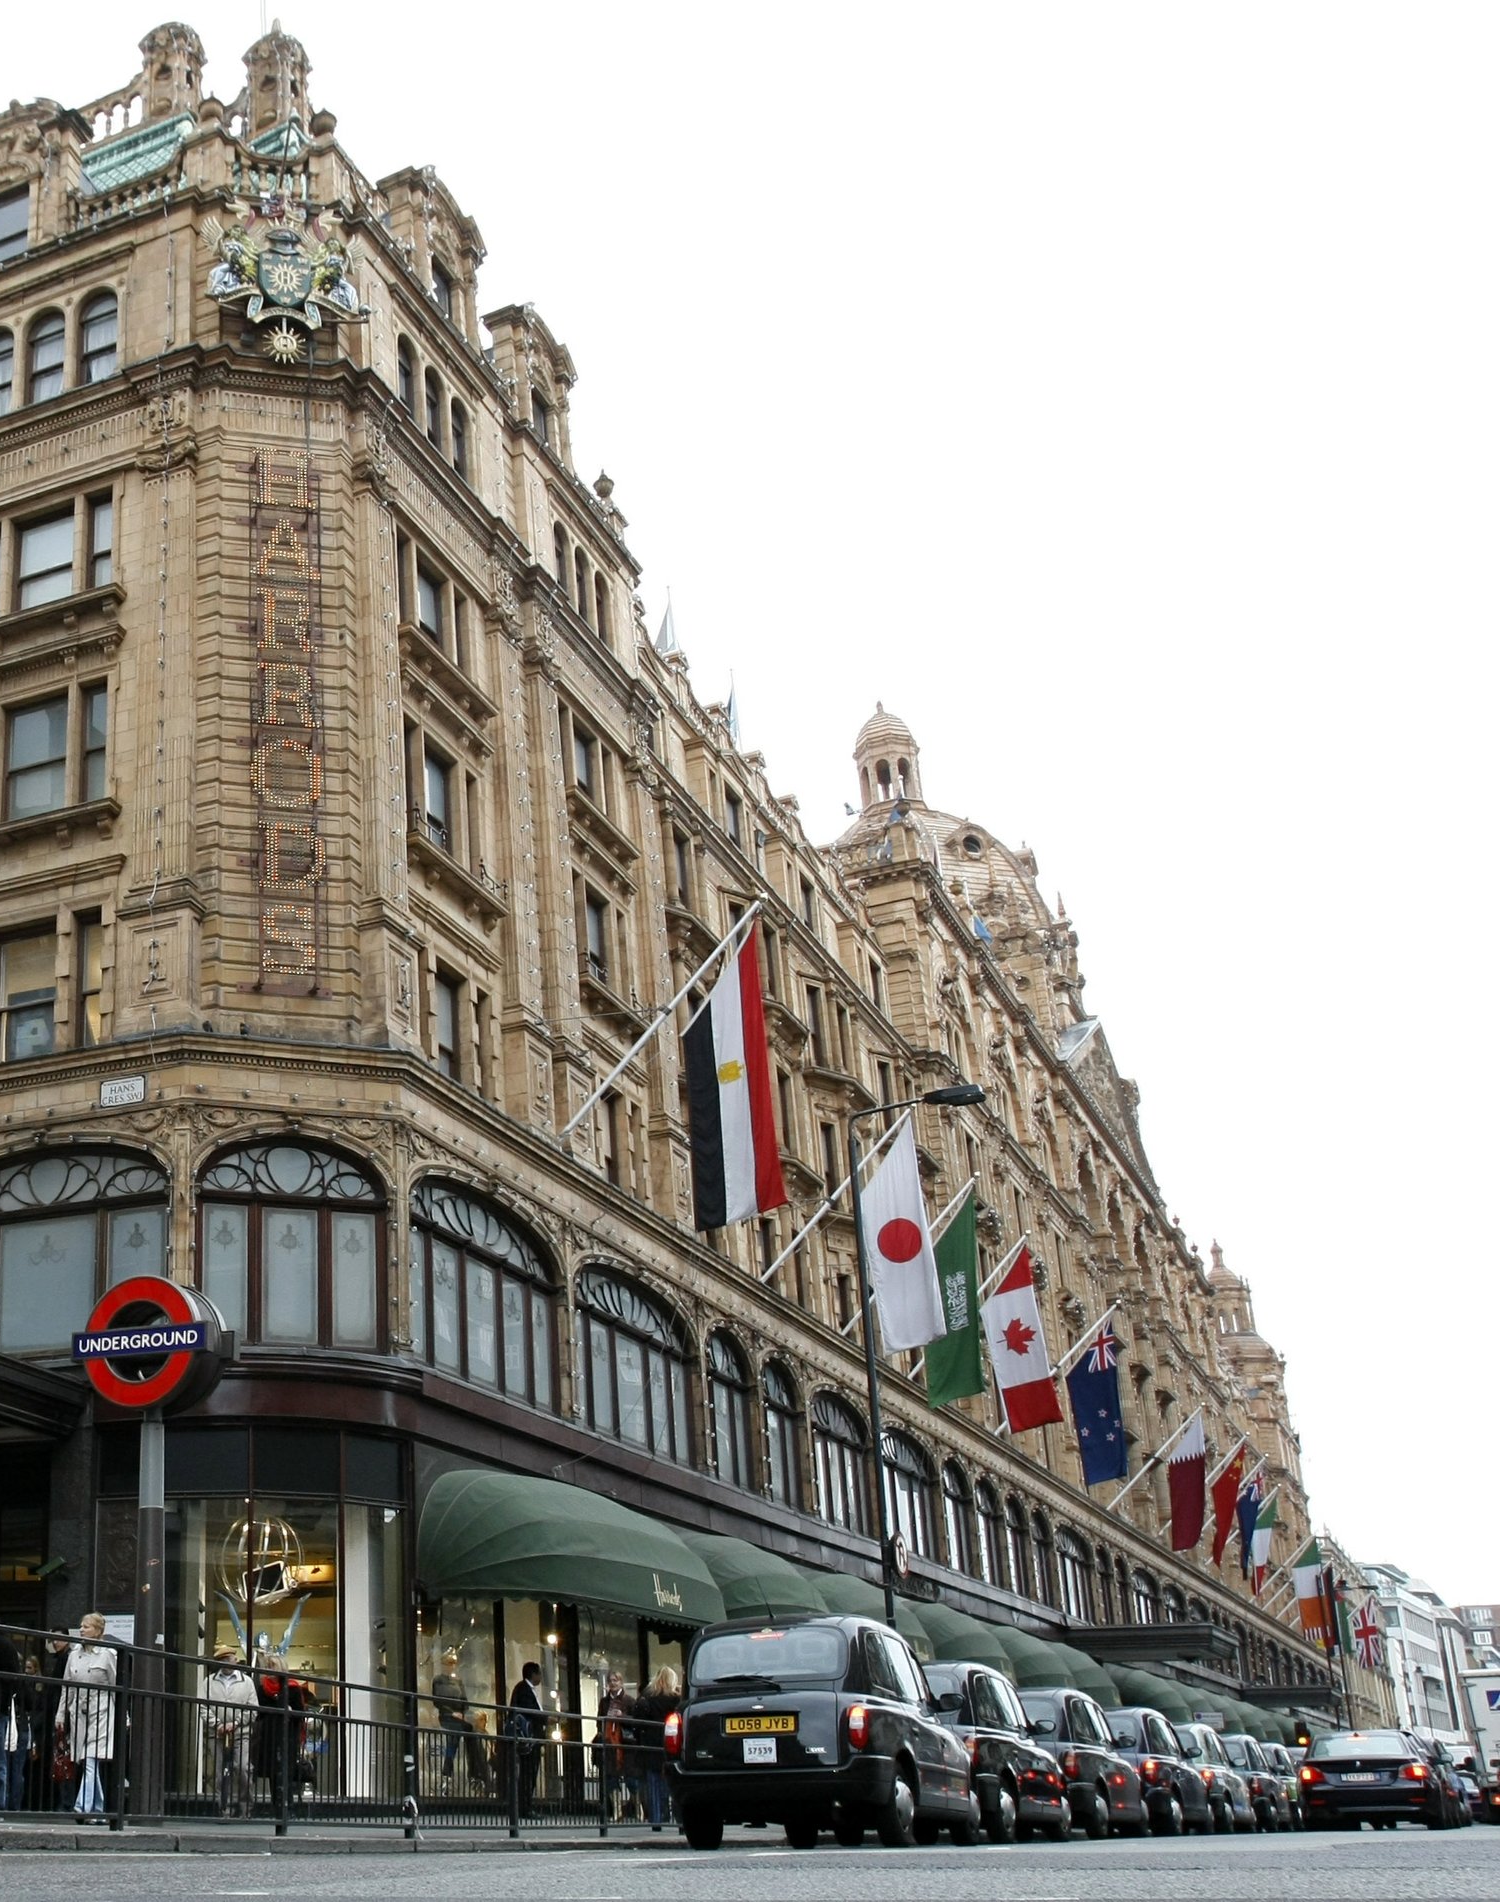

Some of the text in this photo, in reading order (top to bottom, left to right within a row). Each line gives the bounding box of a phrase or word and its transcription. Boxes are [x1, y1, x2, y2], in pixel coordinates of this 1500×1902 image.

[250, 447, 326, 975] HARRODS
[110, 1082, 135, 1095] HANS
[102, 1094, 125, 1106] CRES
[79, 1329, 198, 1354] UNDERGROUND
[653, 1573, 683, 1612] Harrods
[730, 1718, 789, 1731] LO58 JYB
